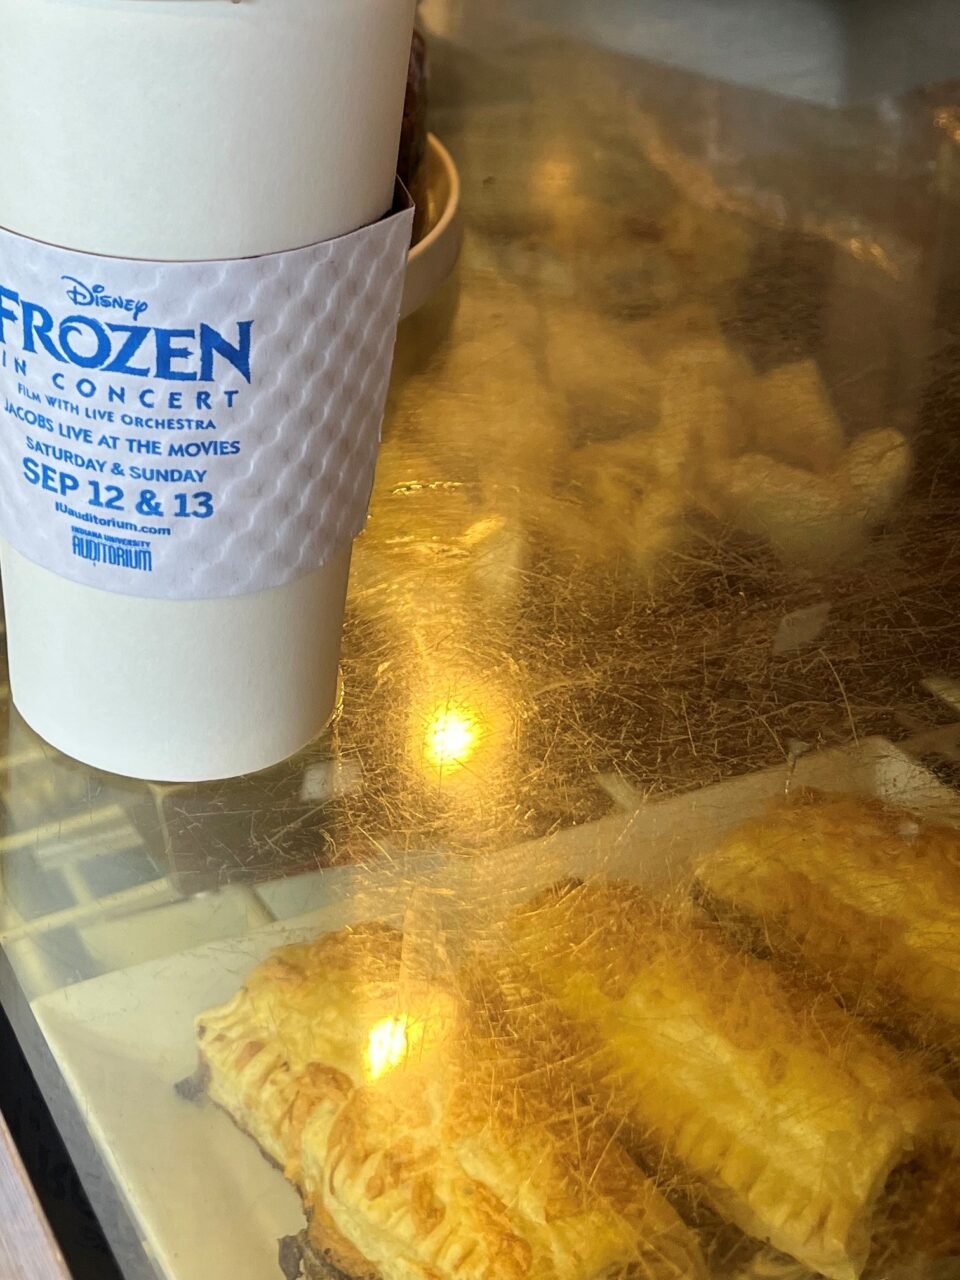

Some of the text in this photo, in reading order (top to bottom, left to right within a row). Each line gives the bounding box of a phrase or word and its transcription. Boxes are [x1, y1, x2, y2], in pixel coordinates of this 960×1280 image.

[61, 275, 148, 321] Disney
[2, 349, 240, 411] IN CONCERT
[4, 397, 241, 458] JACOBS LIVE AT THE MOVIES
[17, 382, 217, 431] FILM WITH LIVE ORCHESTRA
[25, 435, 208, 484] SATURDAY & SUNDAY
[23, 456, 215, 519] SEP 12 & 13
[55, 501, 172, 536] IUauditorium.com
[71, 525, 151, 549] INDIANA UNIVERSITY
[72, 535, 153, 572] AUDITORIUM
